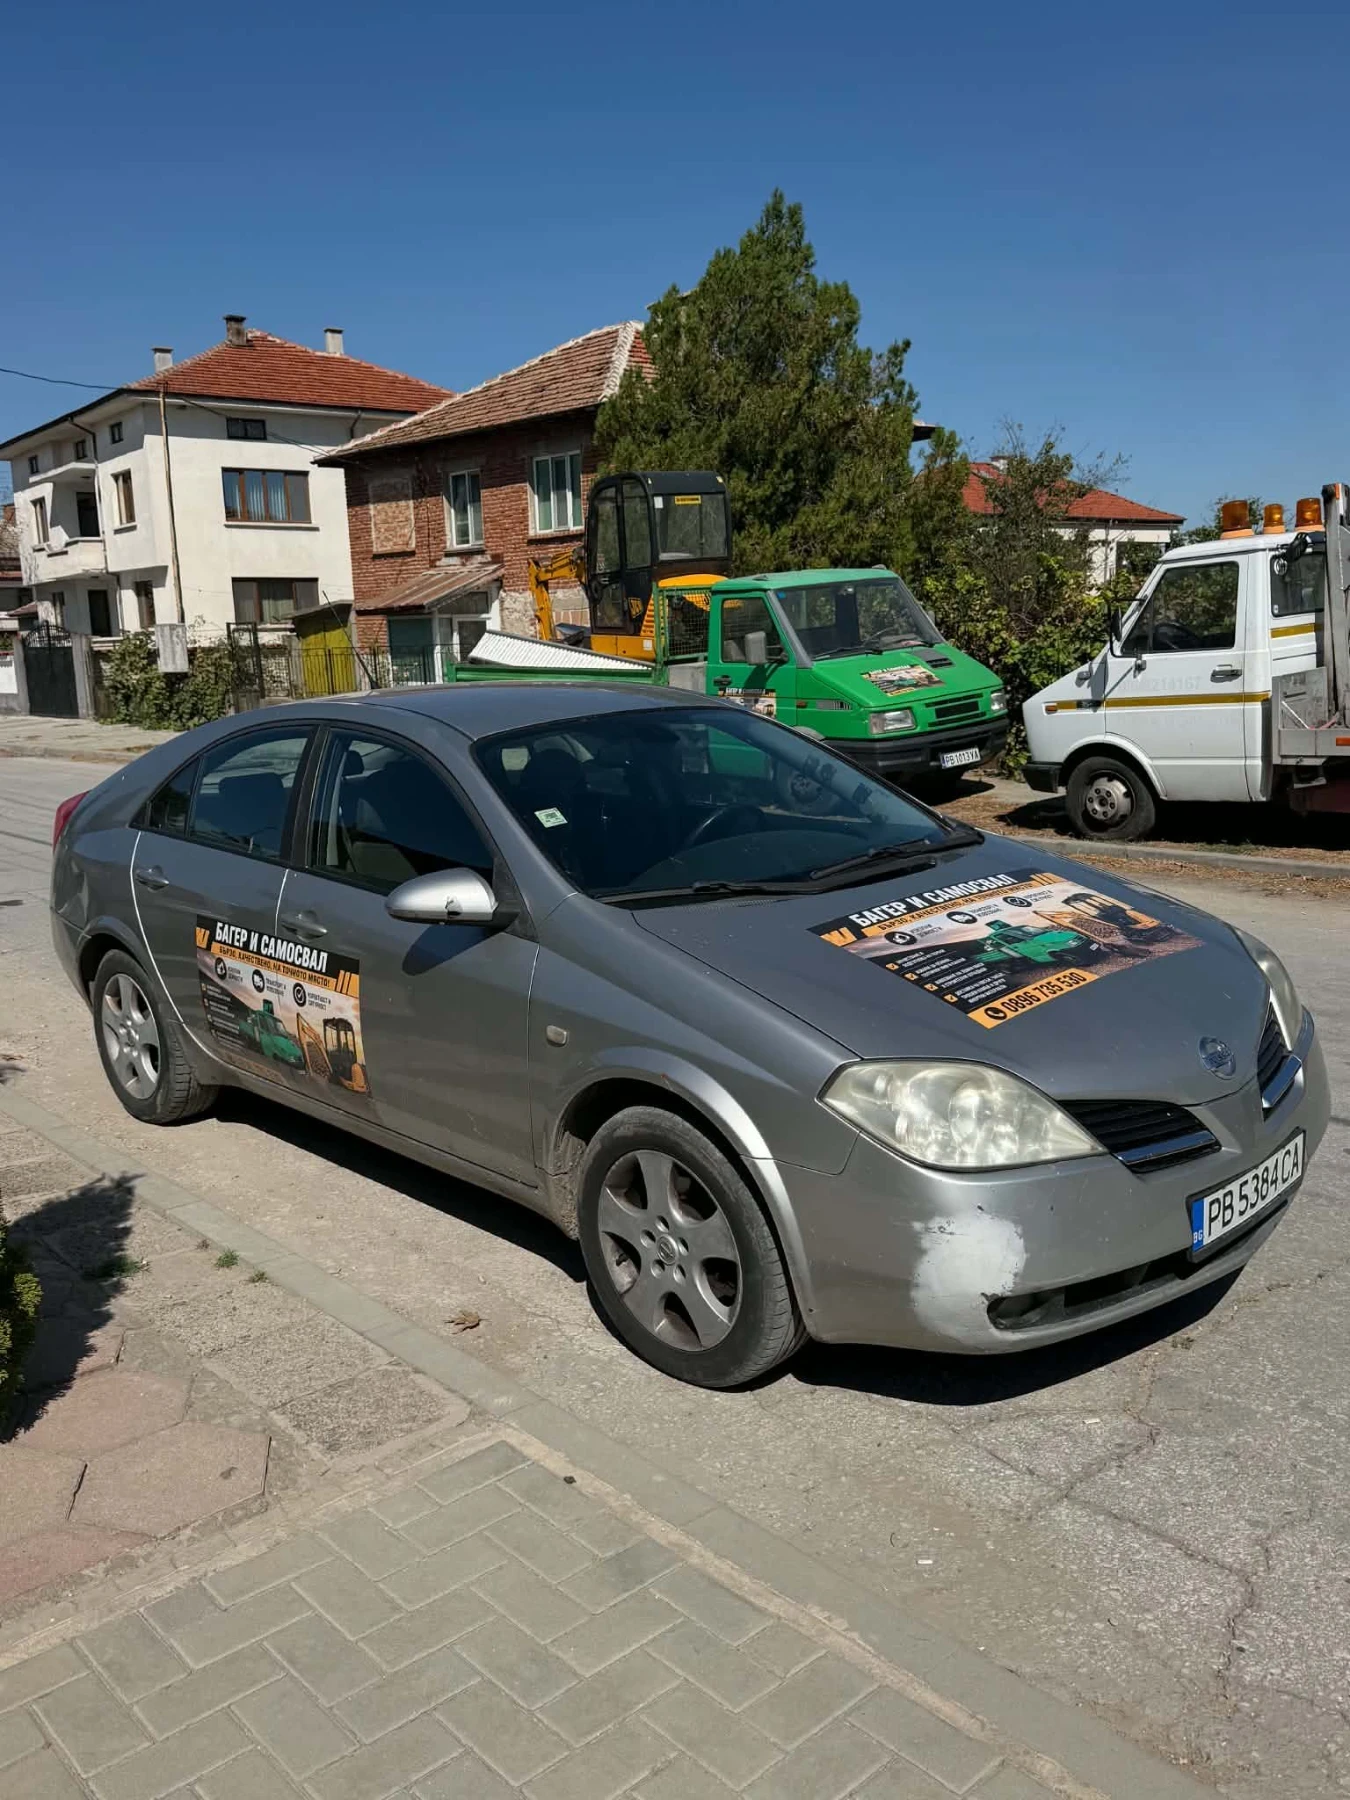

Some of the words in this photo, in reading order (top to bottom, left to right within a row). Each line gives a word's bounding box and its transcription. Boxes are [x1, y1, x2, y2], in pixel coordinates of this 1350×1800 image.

[848, 901, 908, 927] БАГЕР
[905, 896, 930, 908] И
[922, 874, 1018, 903] САМОСВАЛ
[215, 921, 248, 948] БАГЕР
[249, 931, 259, 952] И
[260, 934, 328, 973] САМОСВАЛ
[1001, 991, 1042, 1013] 0896
[1032, 981, 1064, 998] 735
[1055, 971, 1087, 988] 530
[1193, 1230, 1203, 1243] BG
